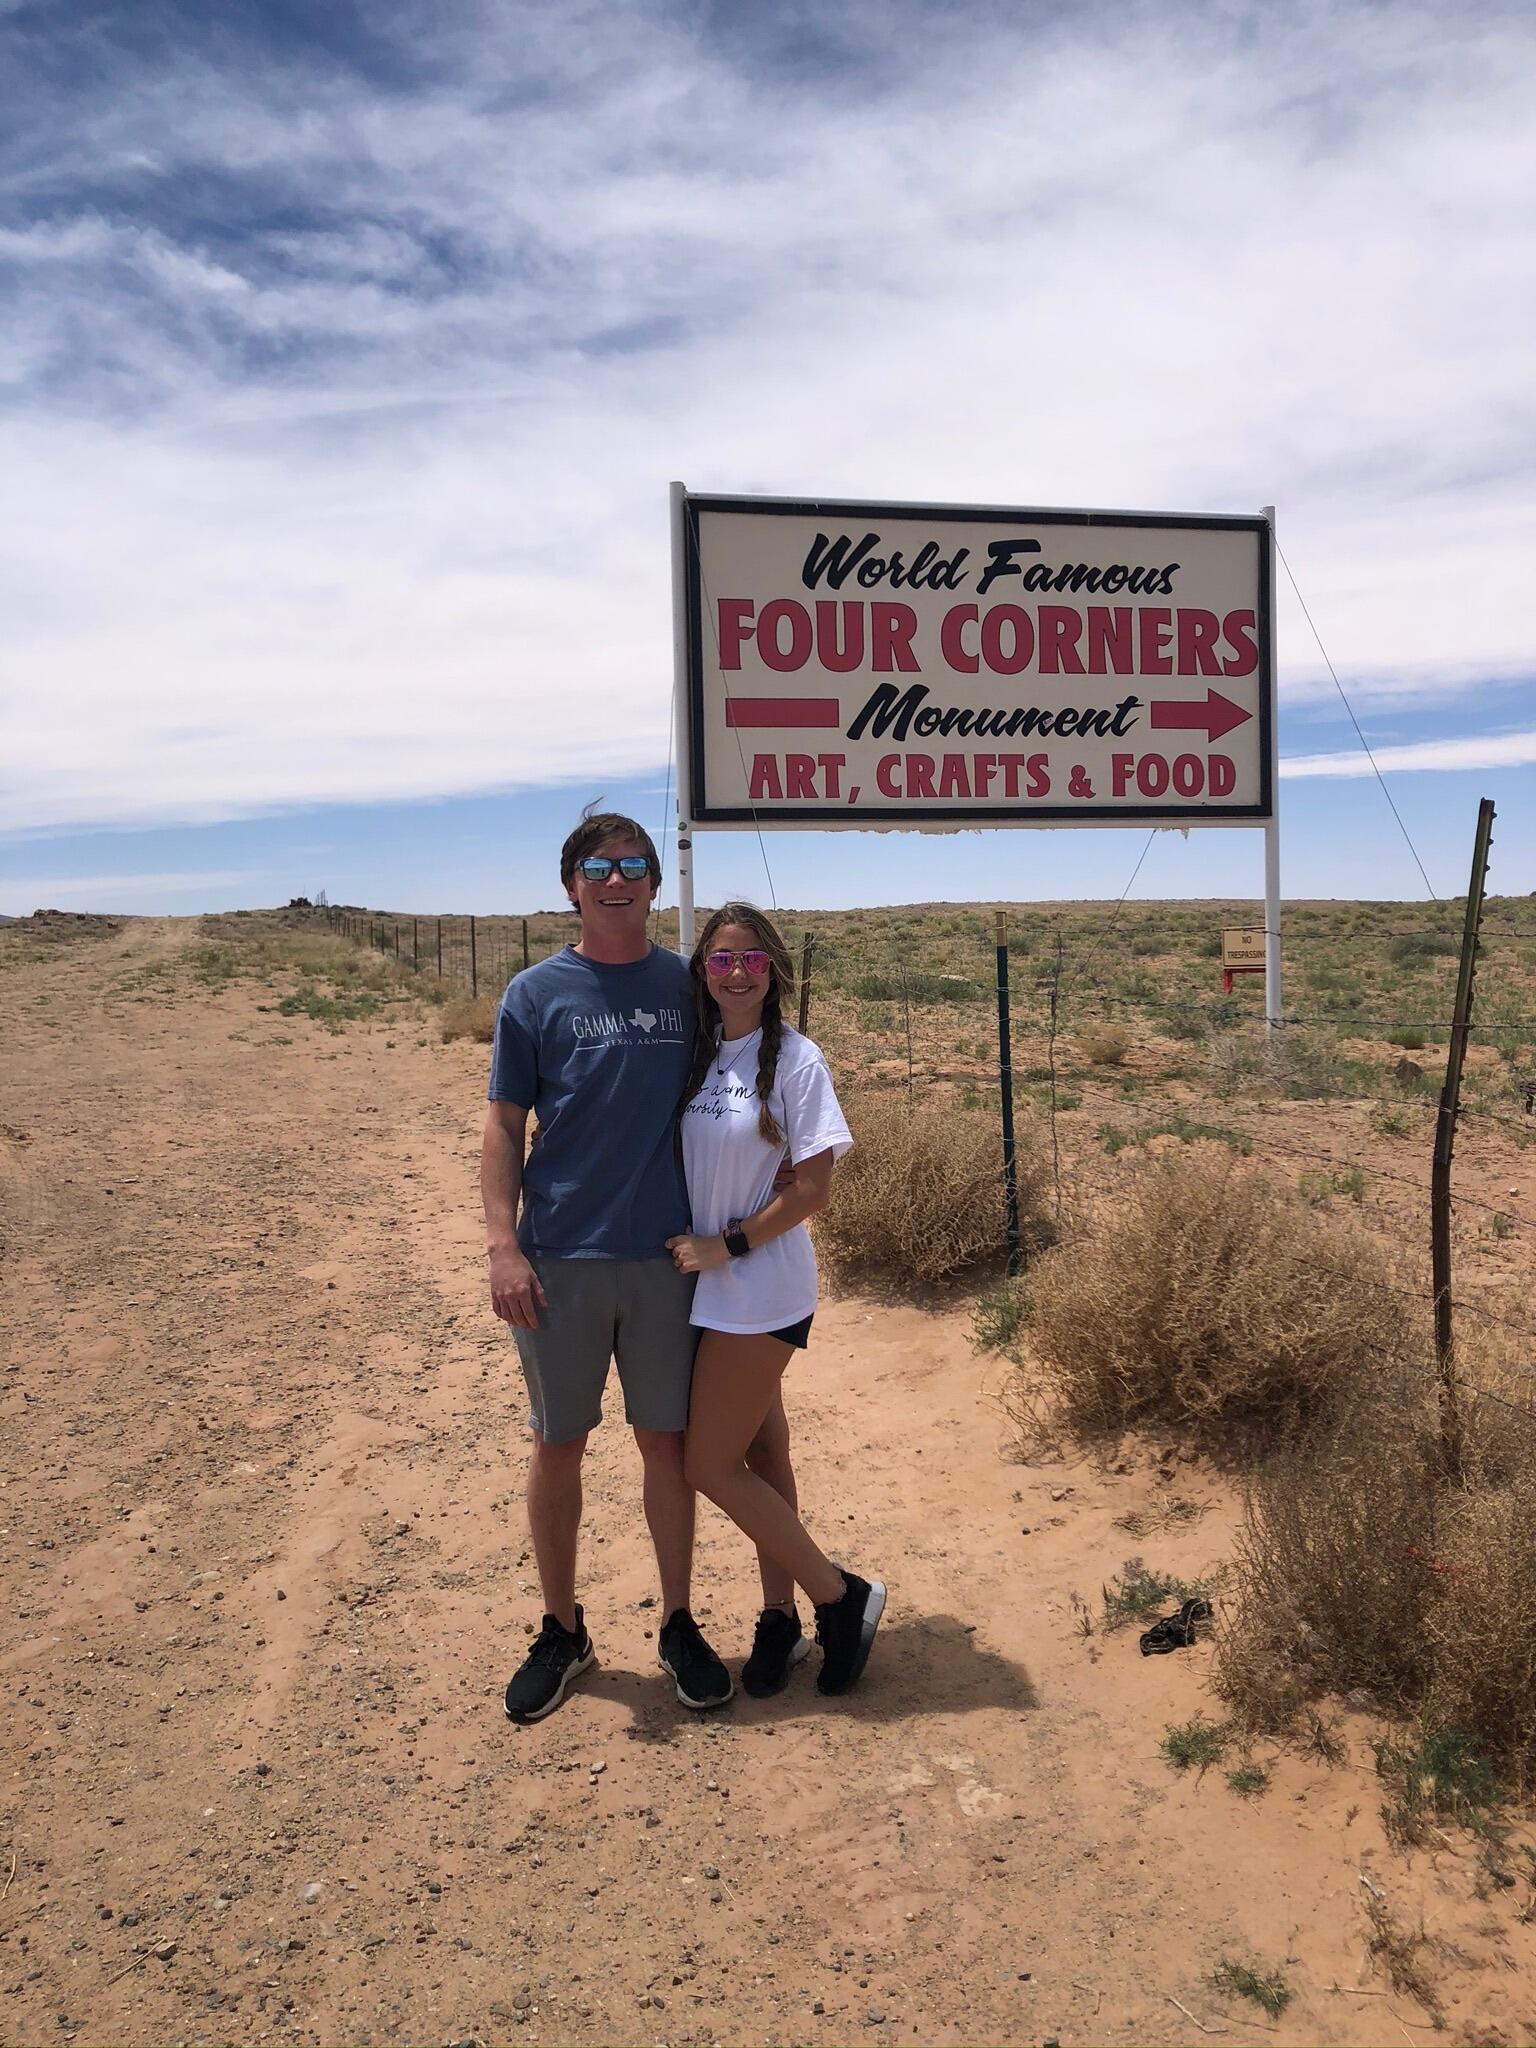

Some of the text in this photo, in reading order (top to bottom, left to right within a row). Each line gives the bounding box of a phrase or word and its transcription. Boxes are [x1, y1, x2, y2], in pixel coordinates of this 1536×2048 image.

[801, 533, 1182, 595] World Famous
[717, 597, 1260, 677] FOUR CORNERS
[846, 682, 1144, 741] Monument
[749, 752, 1236, 804] ART, CRAFTS & FOOD
[1242, 936, 1252, 944] NO
[572, 1008, 684, 1039] GAMMA PHI
[604, 1037, 660, 1048] TEXAS A&M
